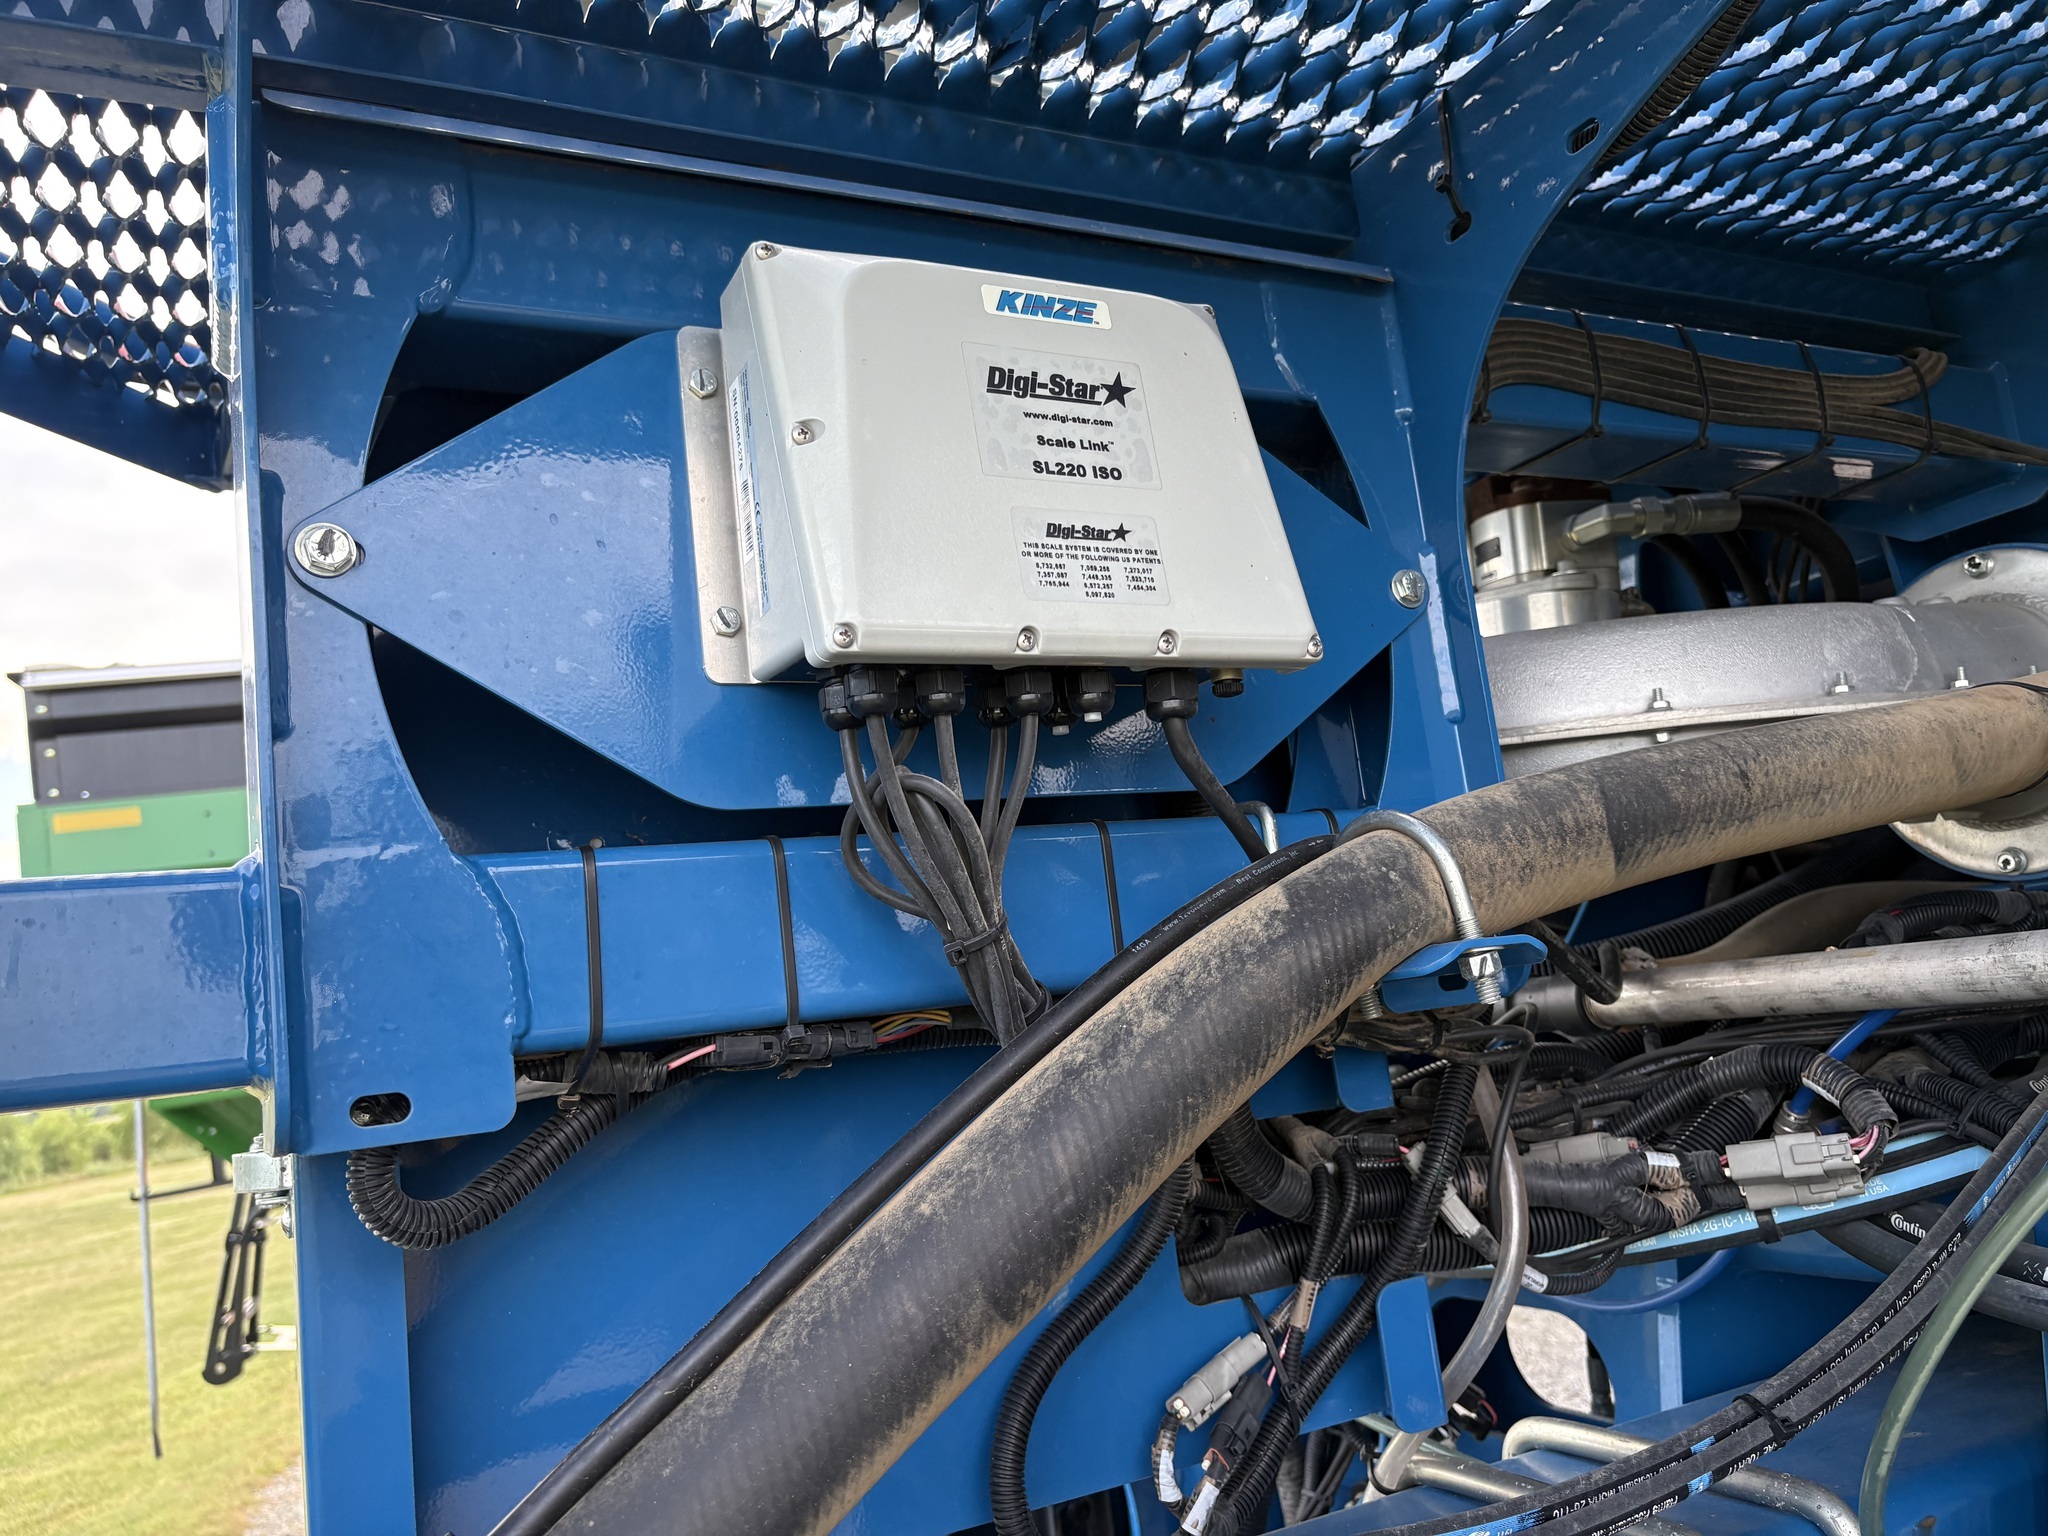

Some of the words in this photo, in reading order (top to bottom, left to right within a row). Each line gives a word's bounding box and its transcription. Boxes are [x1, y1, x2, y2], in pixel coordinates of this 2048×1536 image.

[986, 365, 1103, 406] Digi-Star
[1023, 410, 1113, 428] www.digi-star.com
[1036, 435, 1076, 450] Scale
[1032, 460, 1087, 478] SL220
[1092, 465, 1122, 481] ISO
[1045, 522, 1113, 541] Digi-Star
[1041, 543, 1063, 551] SCALE
[1065, 544, 1092, 552] SYSTEM
[1101, 546, 1133, 555] COVERED
[1033, 551, 1054, 559] MORE
[1081, 554, 1120, 563] FOLLOWING
[1121, 556, 1131, 564] US
[1131, 938, 1152, 954] 14GA
[1235, 873, 1252, 886] Best
[1865, 1177, 1883, 1188] ADE
[1869, 1186, 1890, 1196] USA
